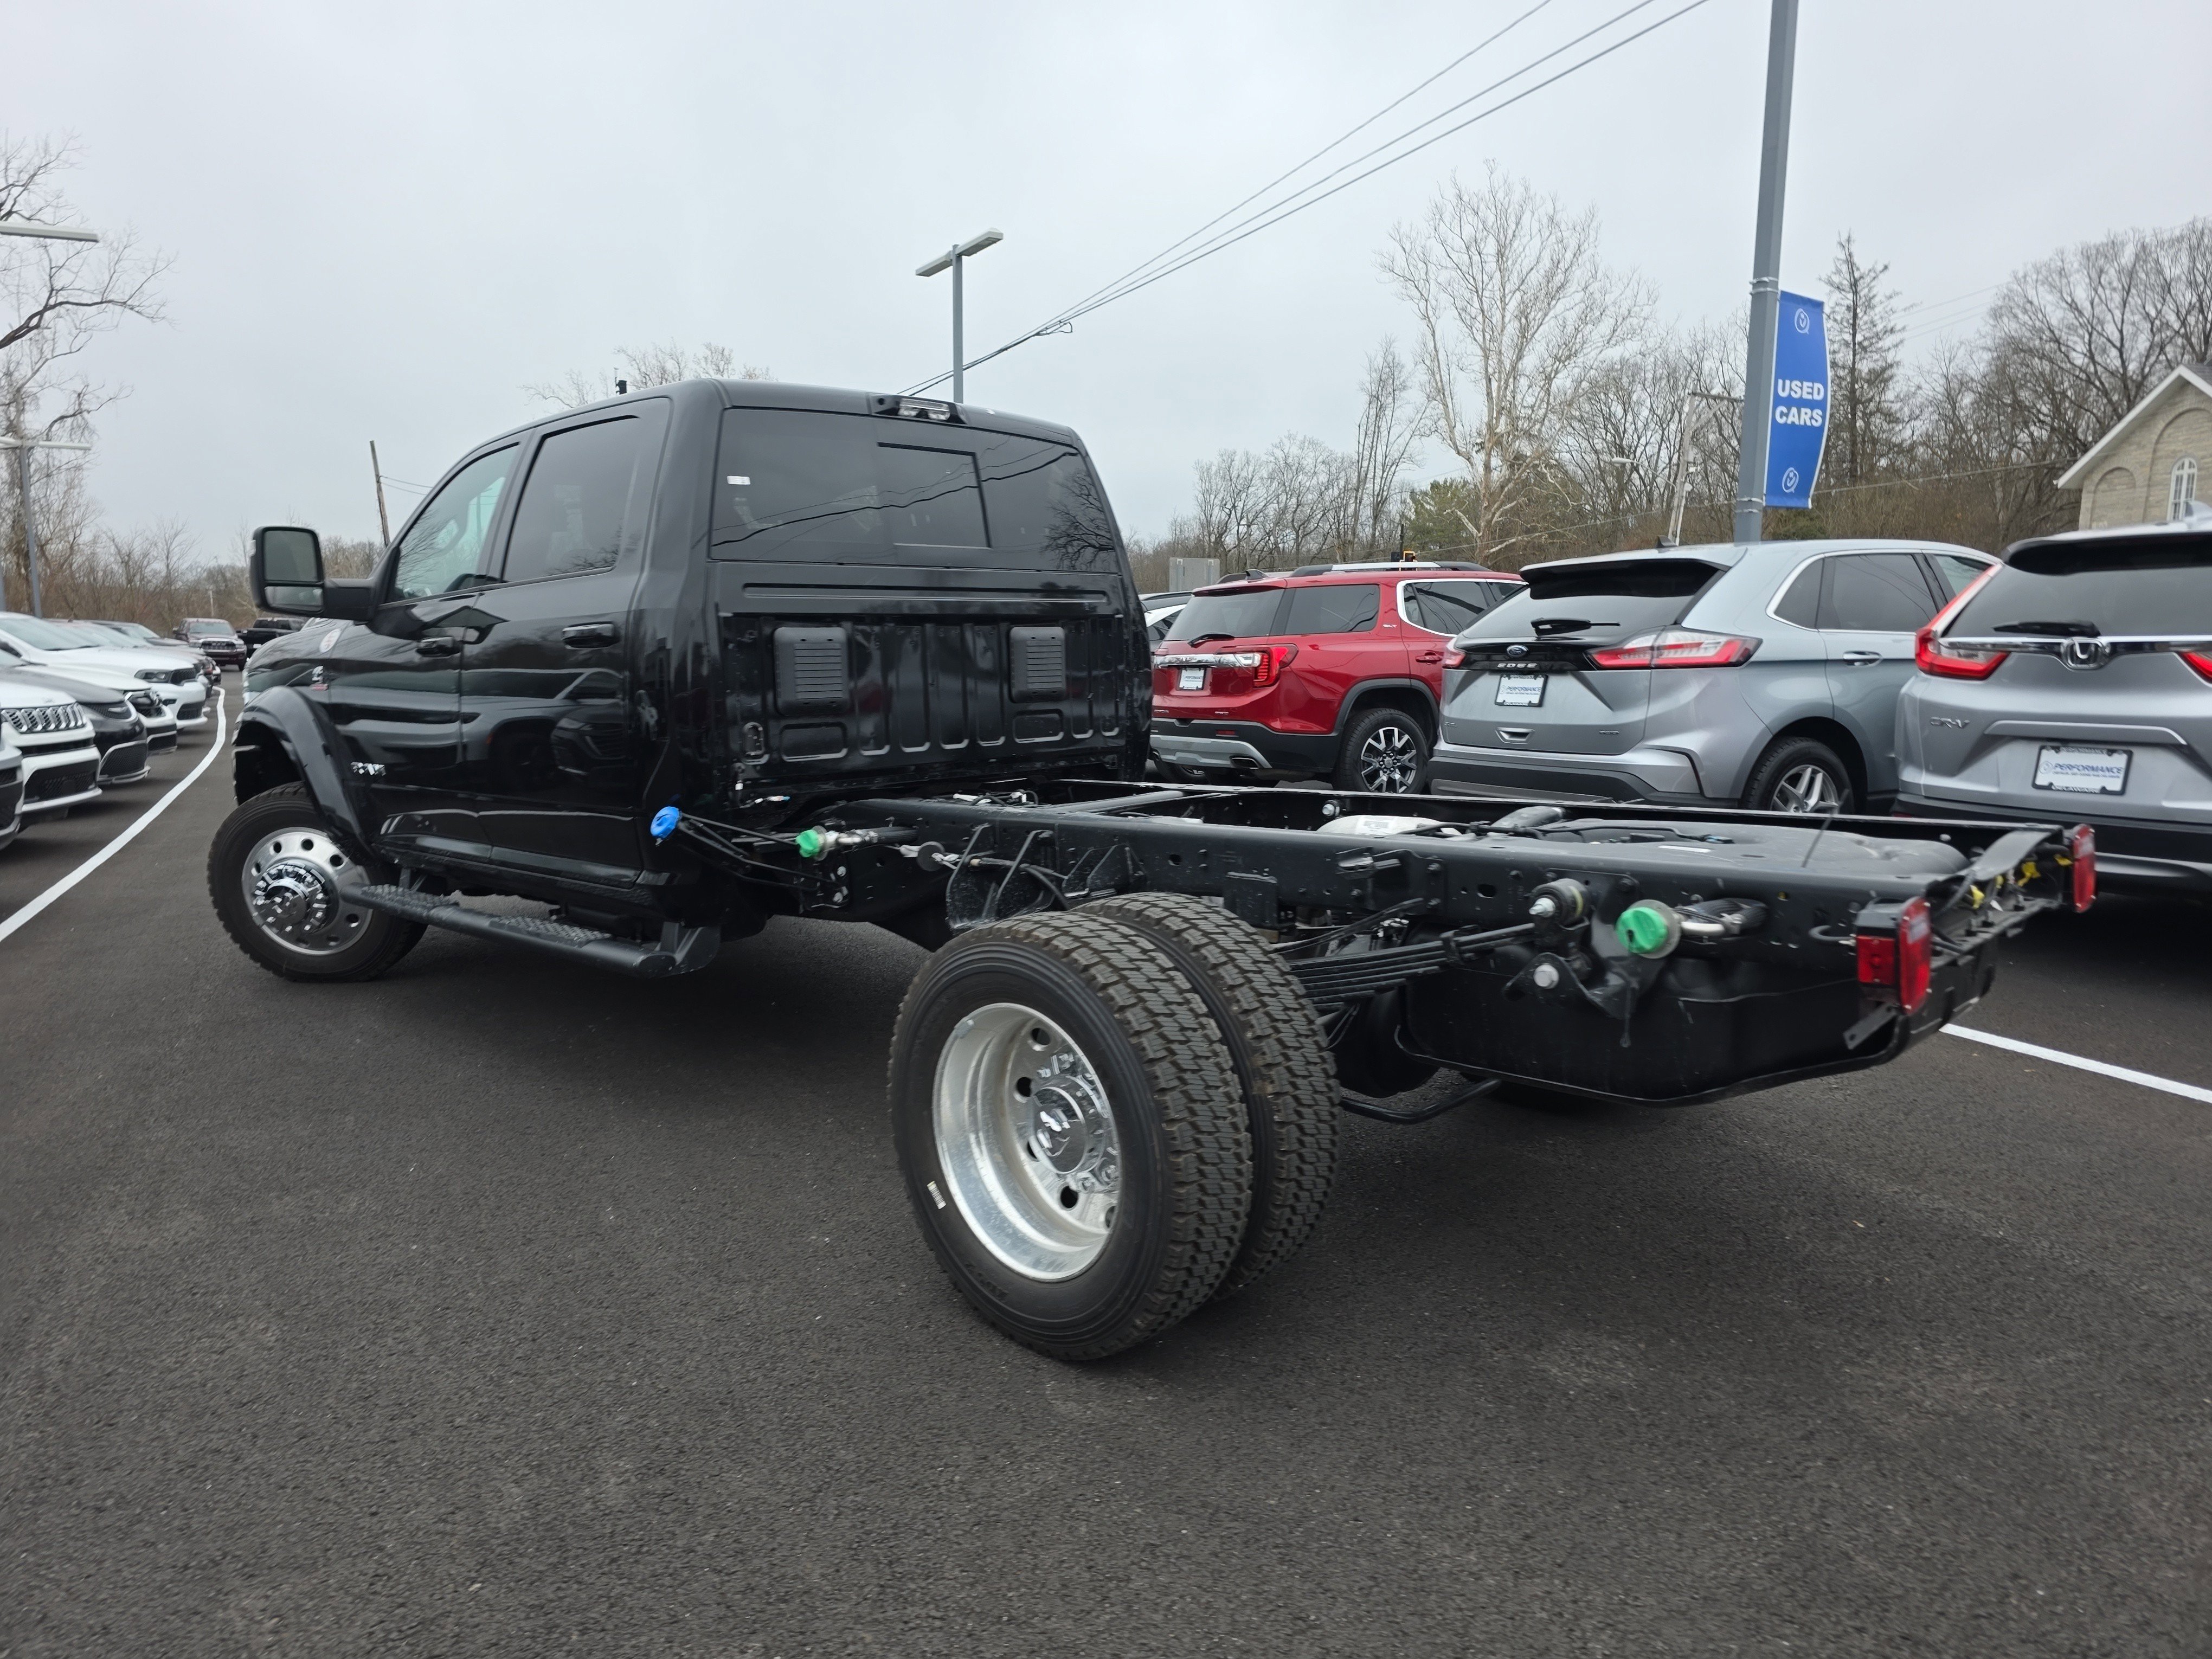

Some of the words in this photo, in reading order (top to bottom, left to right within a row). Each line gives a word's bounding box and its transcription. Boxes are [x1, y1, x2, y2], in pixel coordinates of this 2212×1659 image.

[1777, 379, 1824, 401] USED
[1774, 406, 1823, 427] CARS
[1930, 716, 1970, 728] CR-V
[2054, 762, 2124, 774] PERFORMANCE
